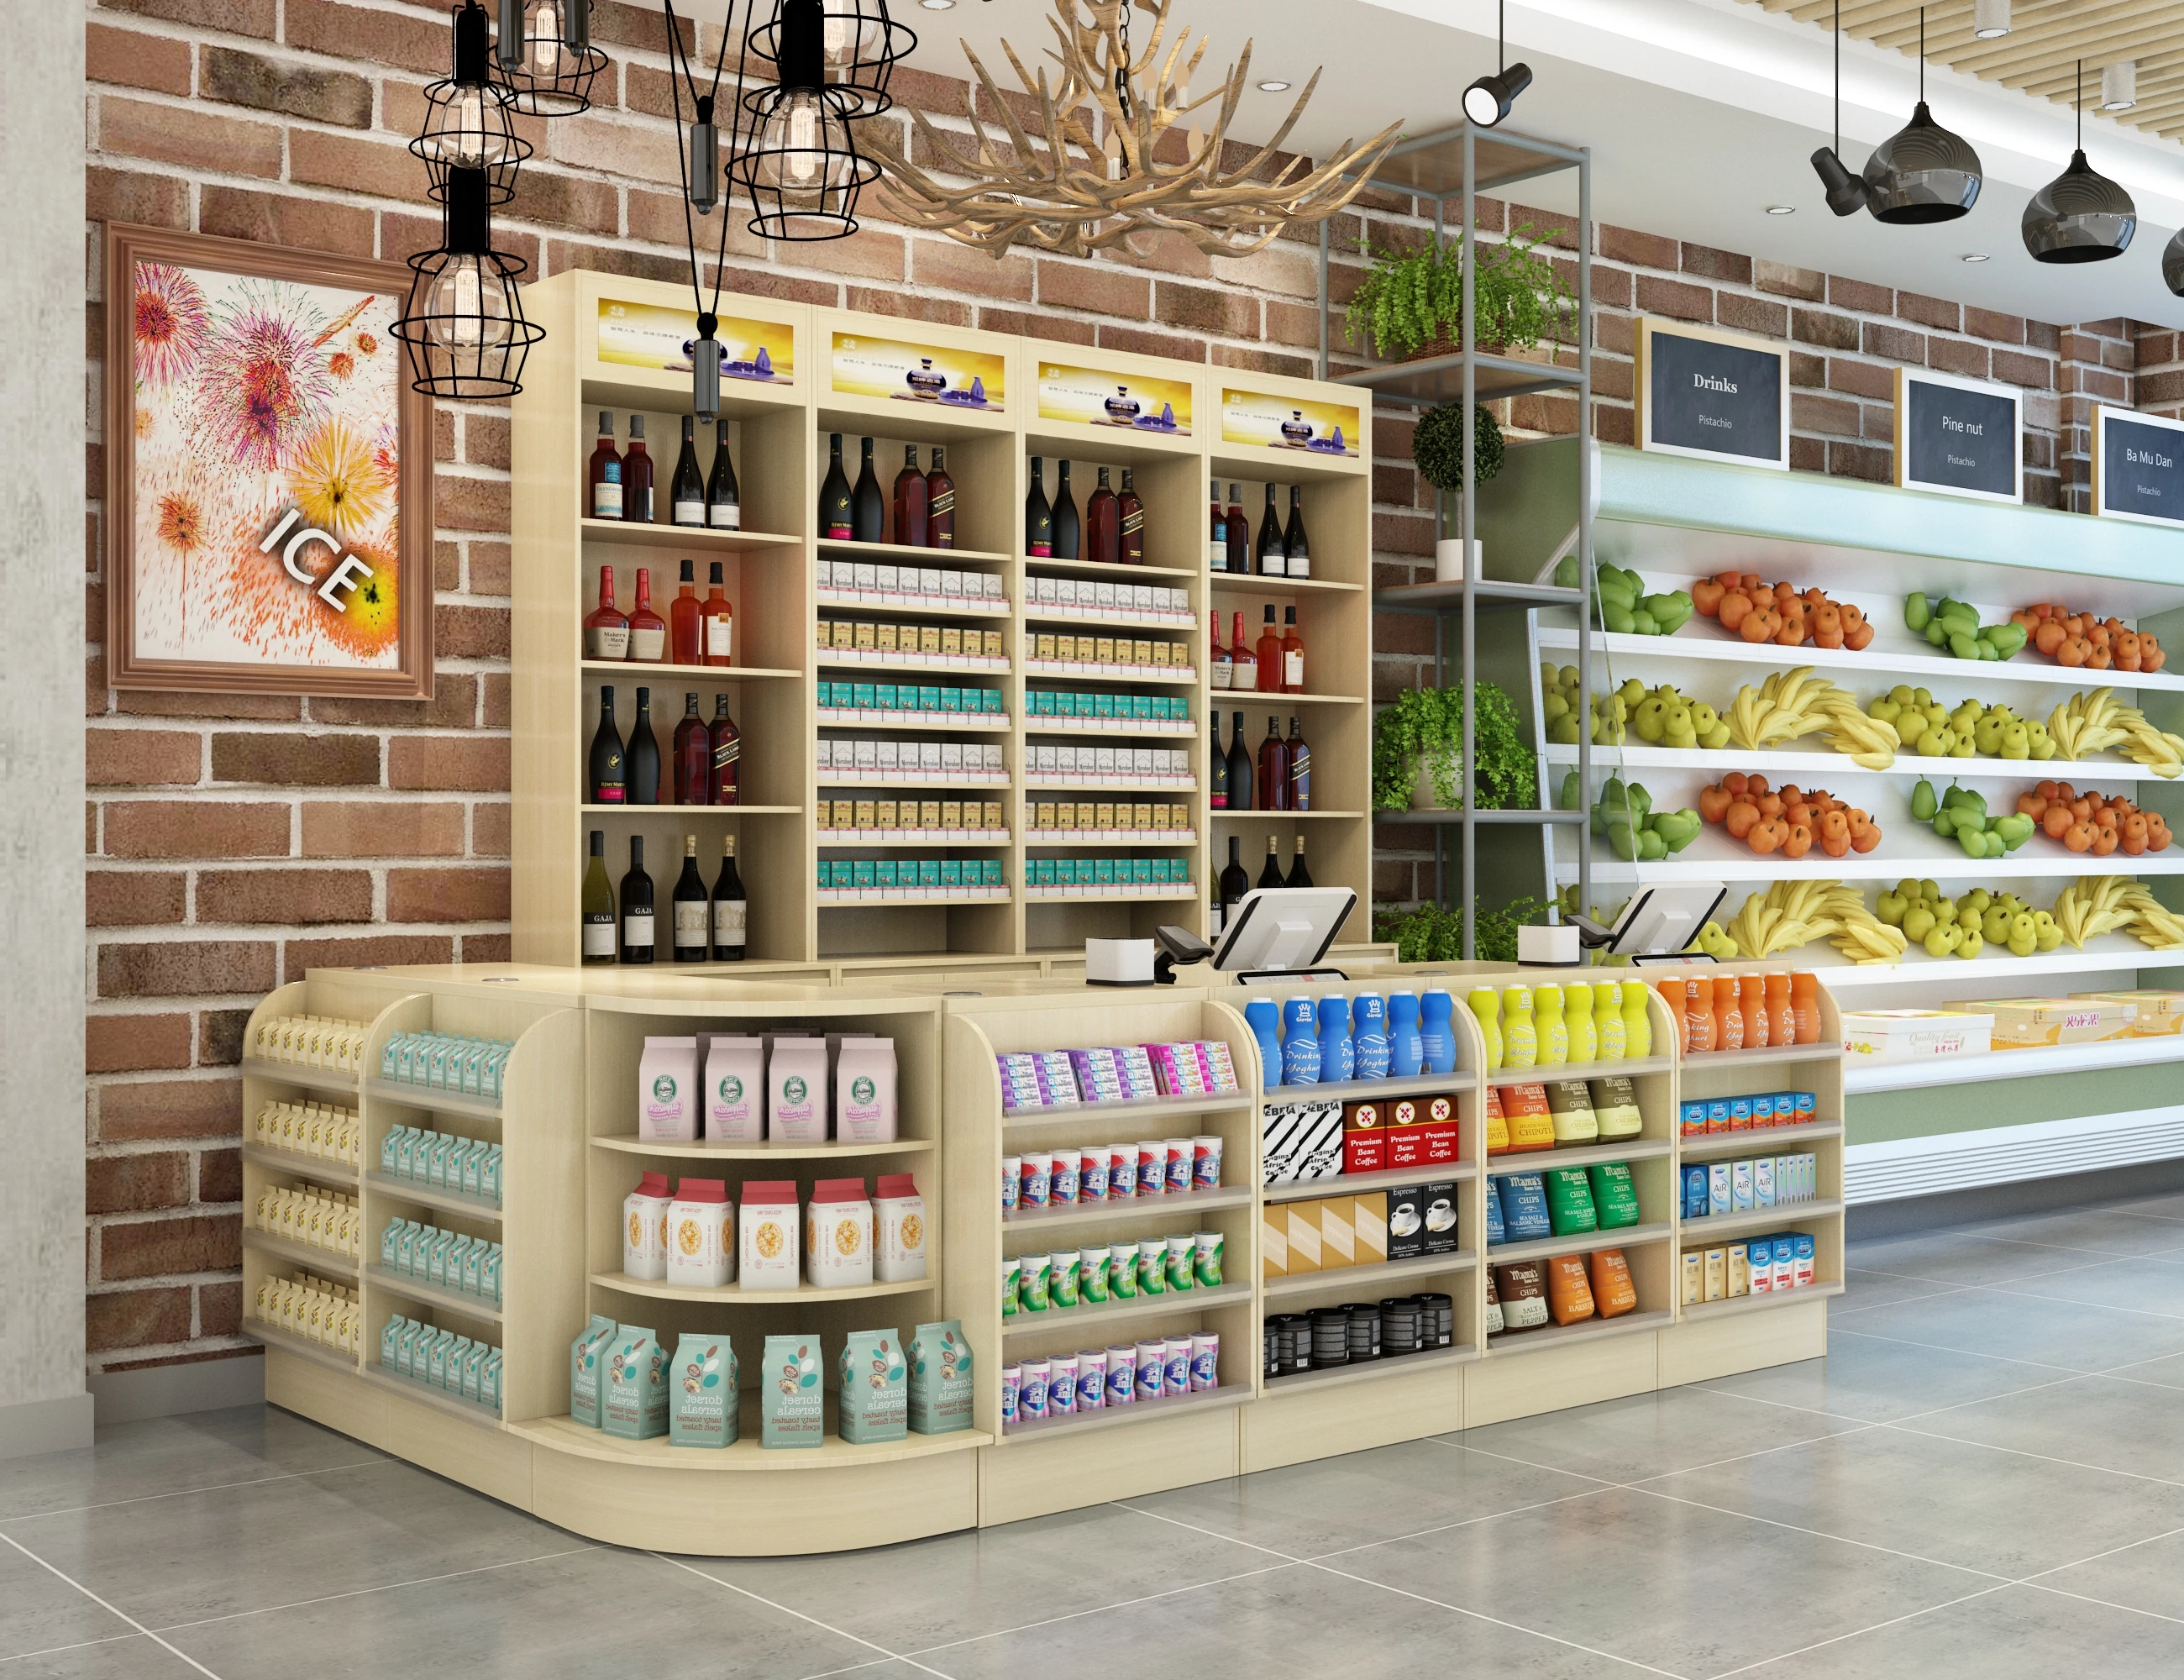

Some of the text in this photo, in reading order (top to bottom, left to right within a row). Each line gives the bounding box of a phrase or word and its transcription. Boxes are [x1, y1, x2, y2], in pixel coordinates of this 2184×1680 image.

[1693, 373, 1738, 394] Drinks
[1698, 415, 1732, 429] Pistachio
[1942, 416, 1983, 436] Pine nut
[1947, 454, 1976, 467] Pistachio
[2127, 449, 2172, 469] Ba Mu Dan
[2137, 485, 2161, 496] Pistachio
[259, 507, 375, 613] ICE
[2066, 1013, 2099, 1028] 火龙果
[1910, 1032, 1960, 1045] Quality fruit
[1391, 1135, 1420, 1143] Premium
[1425, 1131, 1456, 1139] Premium
[1351, 1138, 1383, 1147] Premium
[1355, 1158, 1378, 1166] Coffee
[1559, 1170, 1588, 1181] Mama's
[1603, 1166, 1630, 1176] Mama's
[1509, 1176, 1541, 1187] Mama's
[1393, 1188, 1417, 1197] Espresso
[1614, 1184, 1630, 1193] CHIPS
[1509, 1268, 1538, 1280] Mama's
[1615, 1273, 1628, 1282] CHIPS
[1572, 1280, 1586, 1289] CHIPS
[1520, 1288, 1538, 1296] CHIPS
[1522, 1315, 1546, 1325] PEPPER
